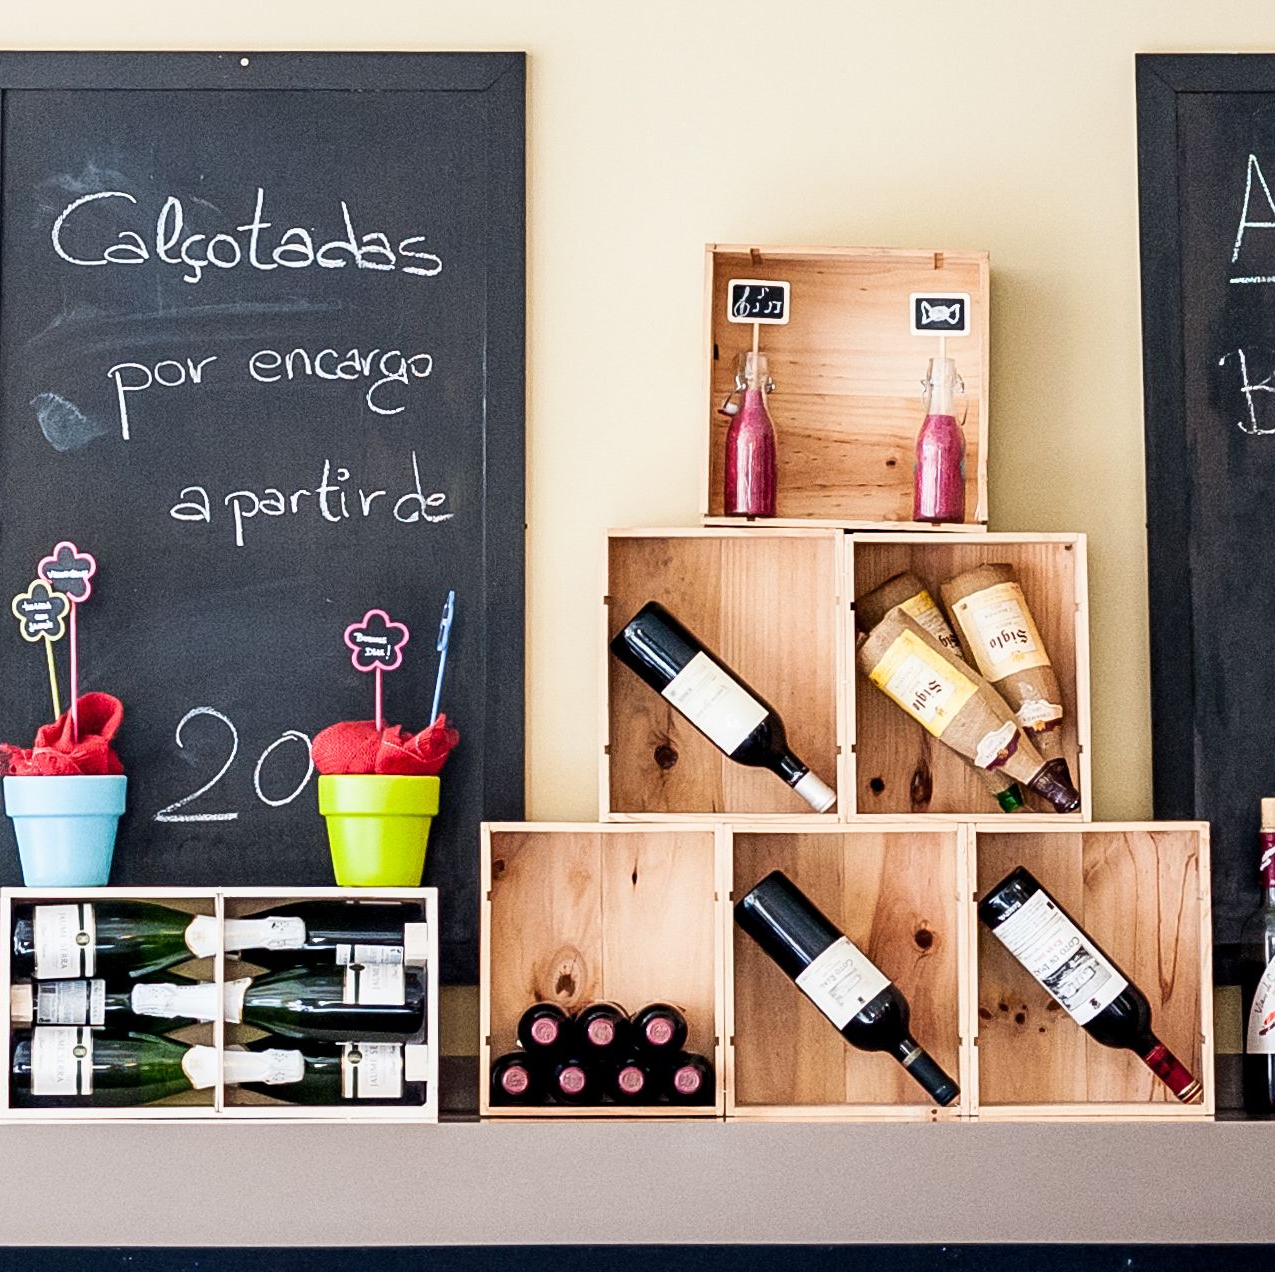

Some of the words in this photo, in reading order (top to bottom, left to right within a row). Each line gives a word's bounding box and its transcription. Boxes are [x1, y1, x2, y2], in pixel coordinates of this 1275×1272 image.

[51, 187, 443, 283] Calçotadas
[107, 355, 218, 440] por
[249, 347, 433, 415] encargo
[170, 485, 210, 524] a
[225, 458, 386, 547] partir
[393, 450, 454, 524] de
[989, 629, 1029, 650] Siglo
[154, 705, 317, 823] 20
